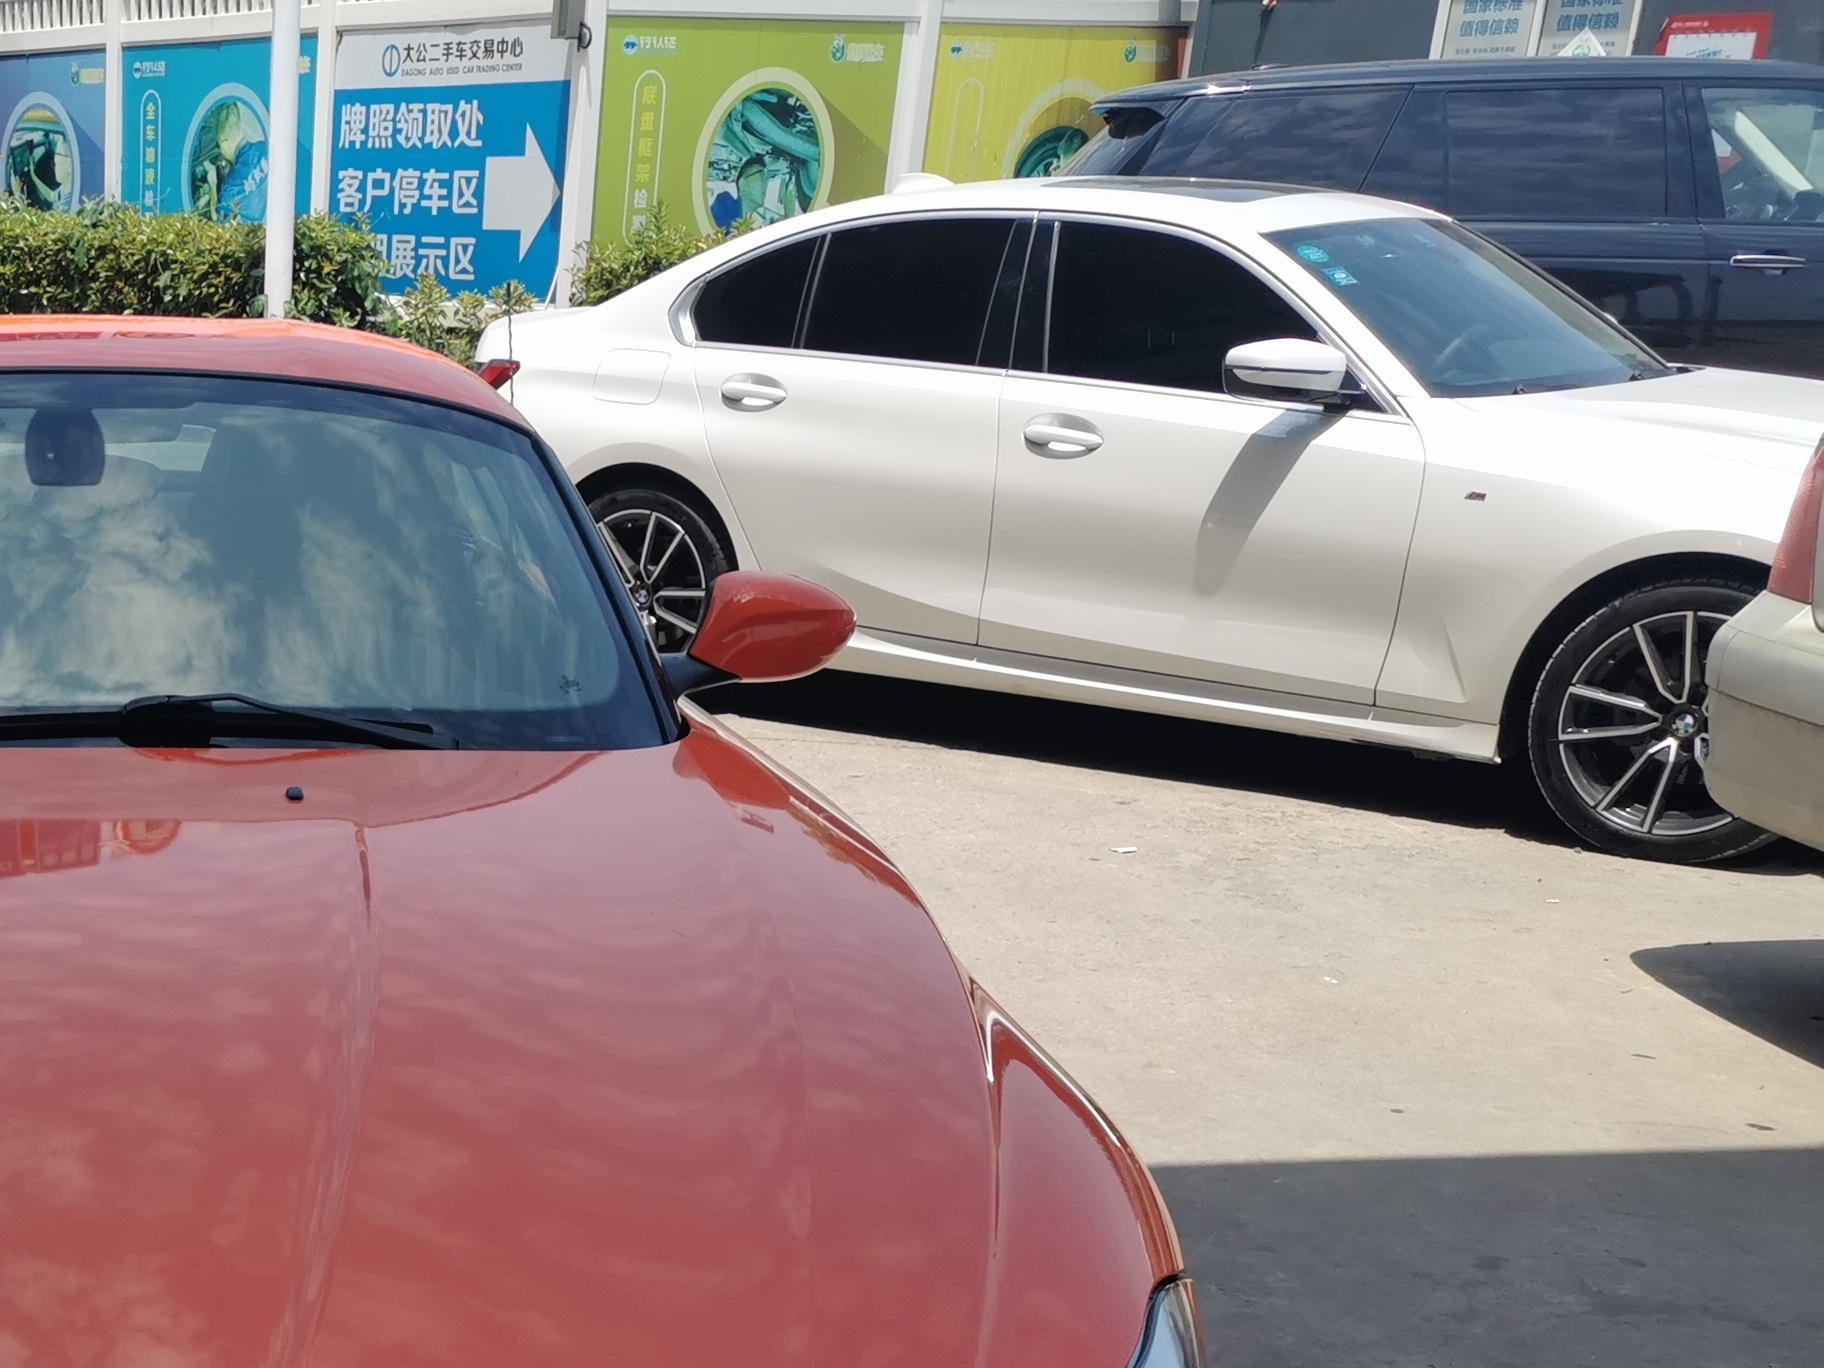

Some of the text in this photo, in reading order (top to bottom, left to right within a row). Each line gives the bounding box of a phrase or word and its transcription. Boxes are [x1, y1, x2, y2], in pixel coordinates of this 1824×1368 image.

[1460, 18, 1520, 37] 值得信赖
[402, 36, 523, 64] 大公二手车交易中心
[462, 64, 474, 74] CAR
[501, 62, 523, 72] CENTER
[339, 99, 484, 149] 牌照领取处
[144, 102, 156, 215] 全车油漆检
[337, 168, 480, 216] 客户停车区
